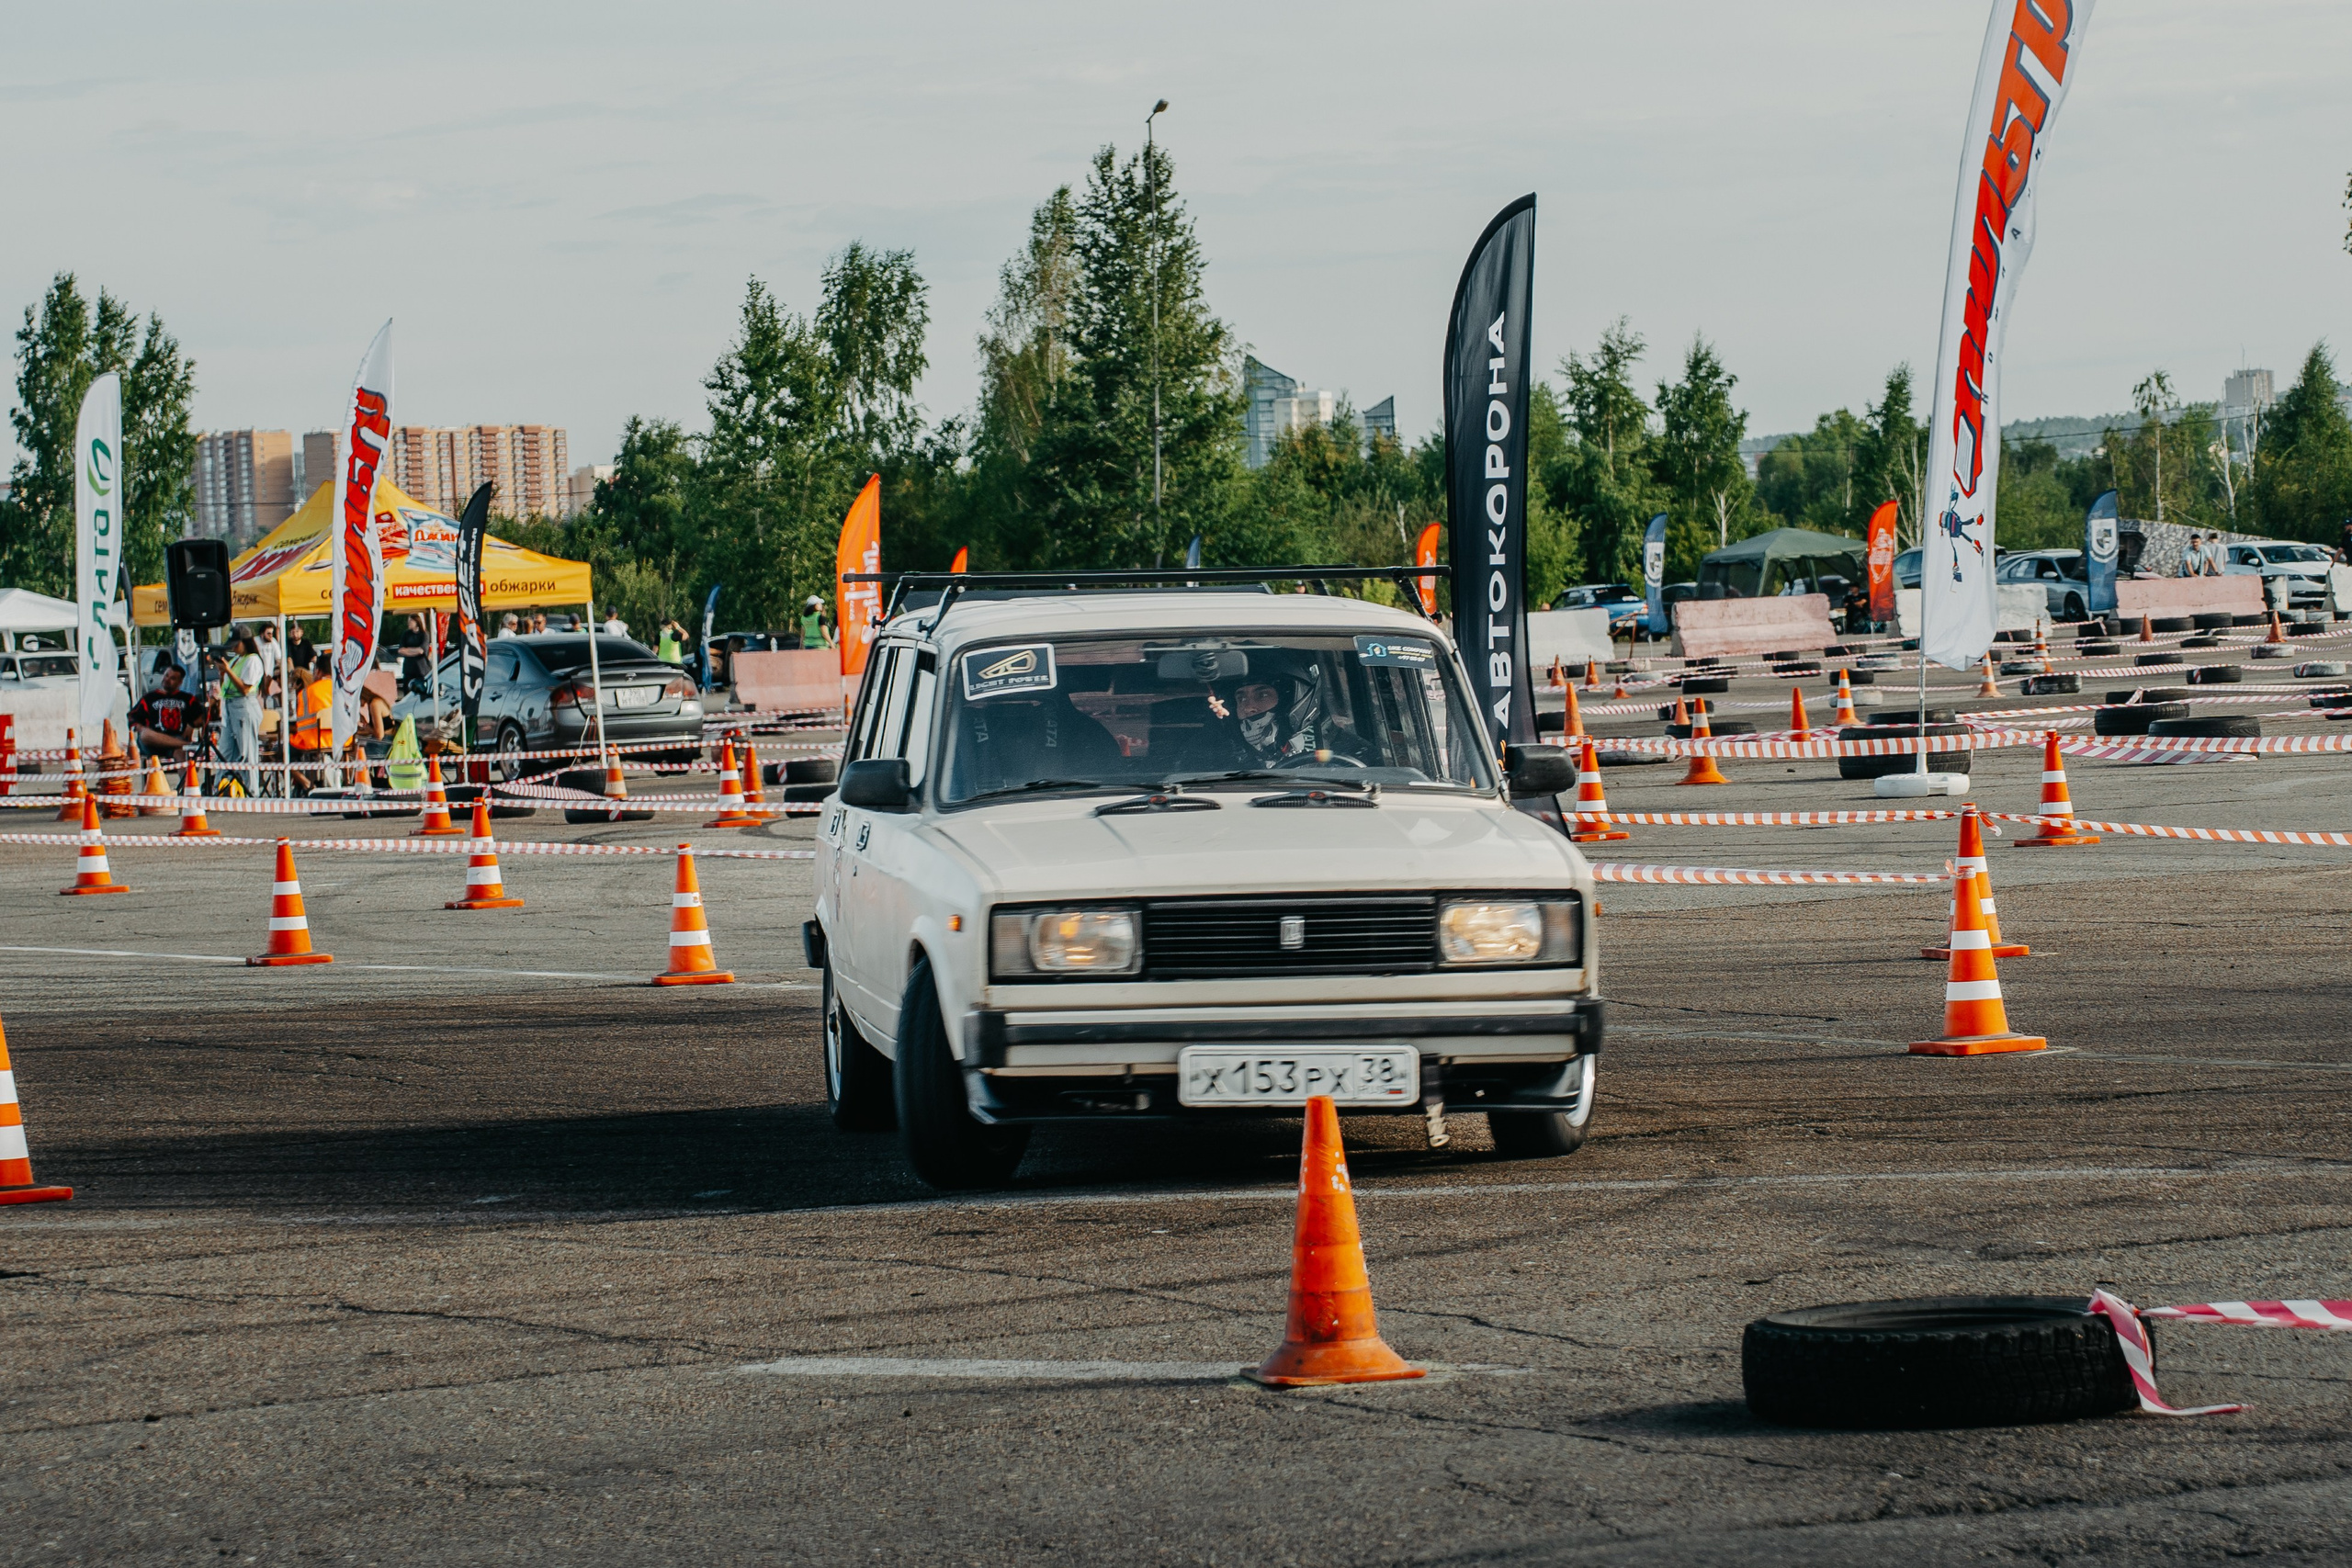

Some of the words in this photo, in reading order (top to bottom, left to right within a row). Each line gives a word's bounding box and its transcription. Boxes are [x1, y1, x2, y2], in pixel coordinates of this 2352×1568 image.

[1485, 310, 1511, 729] АВТОКОРОНА
[490, 579, 556, 596] обжарки
[1360, 1057, 1394, 1083] 38
